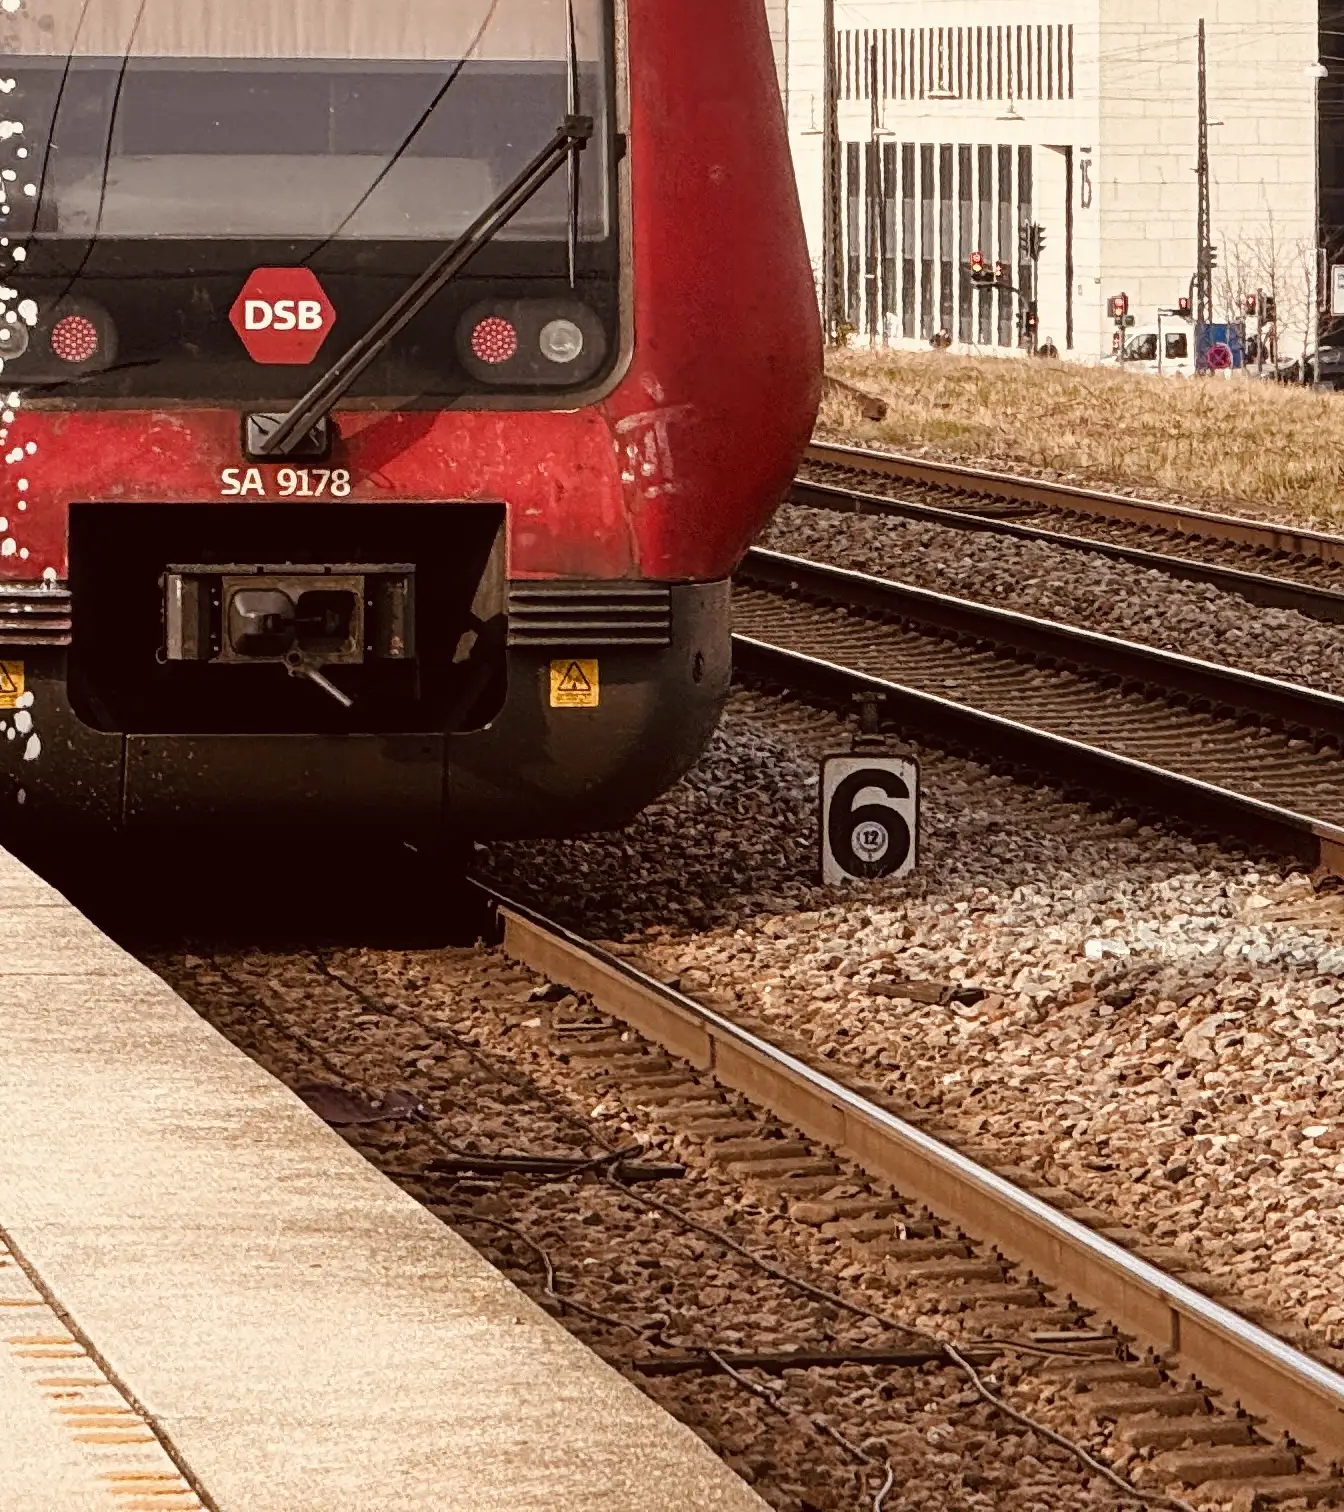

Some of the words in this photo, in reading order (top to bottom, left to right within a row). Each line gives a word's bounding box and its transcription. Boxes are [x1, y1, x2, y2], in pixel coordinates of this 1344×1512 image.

[244, 299, 323, 330] DSB
[220, 468, 265, 496] SA
[276, 468, 351, 497] 9178
[828, 768, 911, 879] 6
[863, 830, 879, 845] 12
